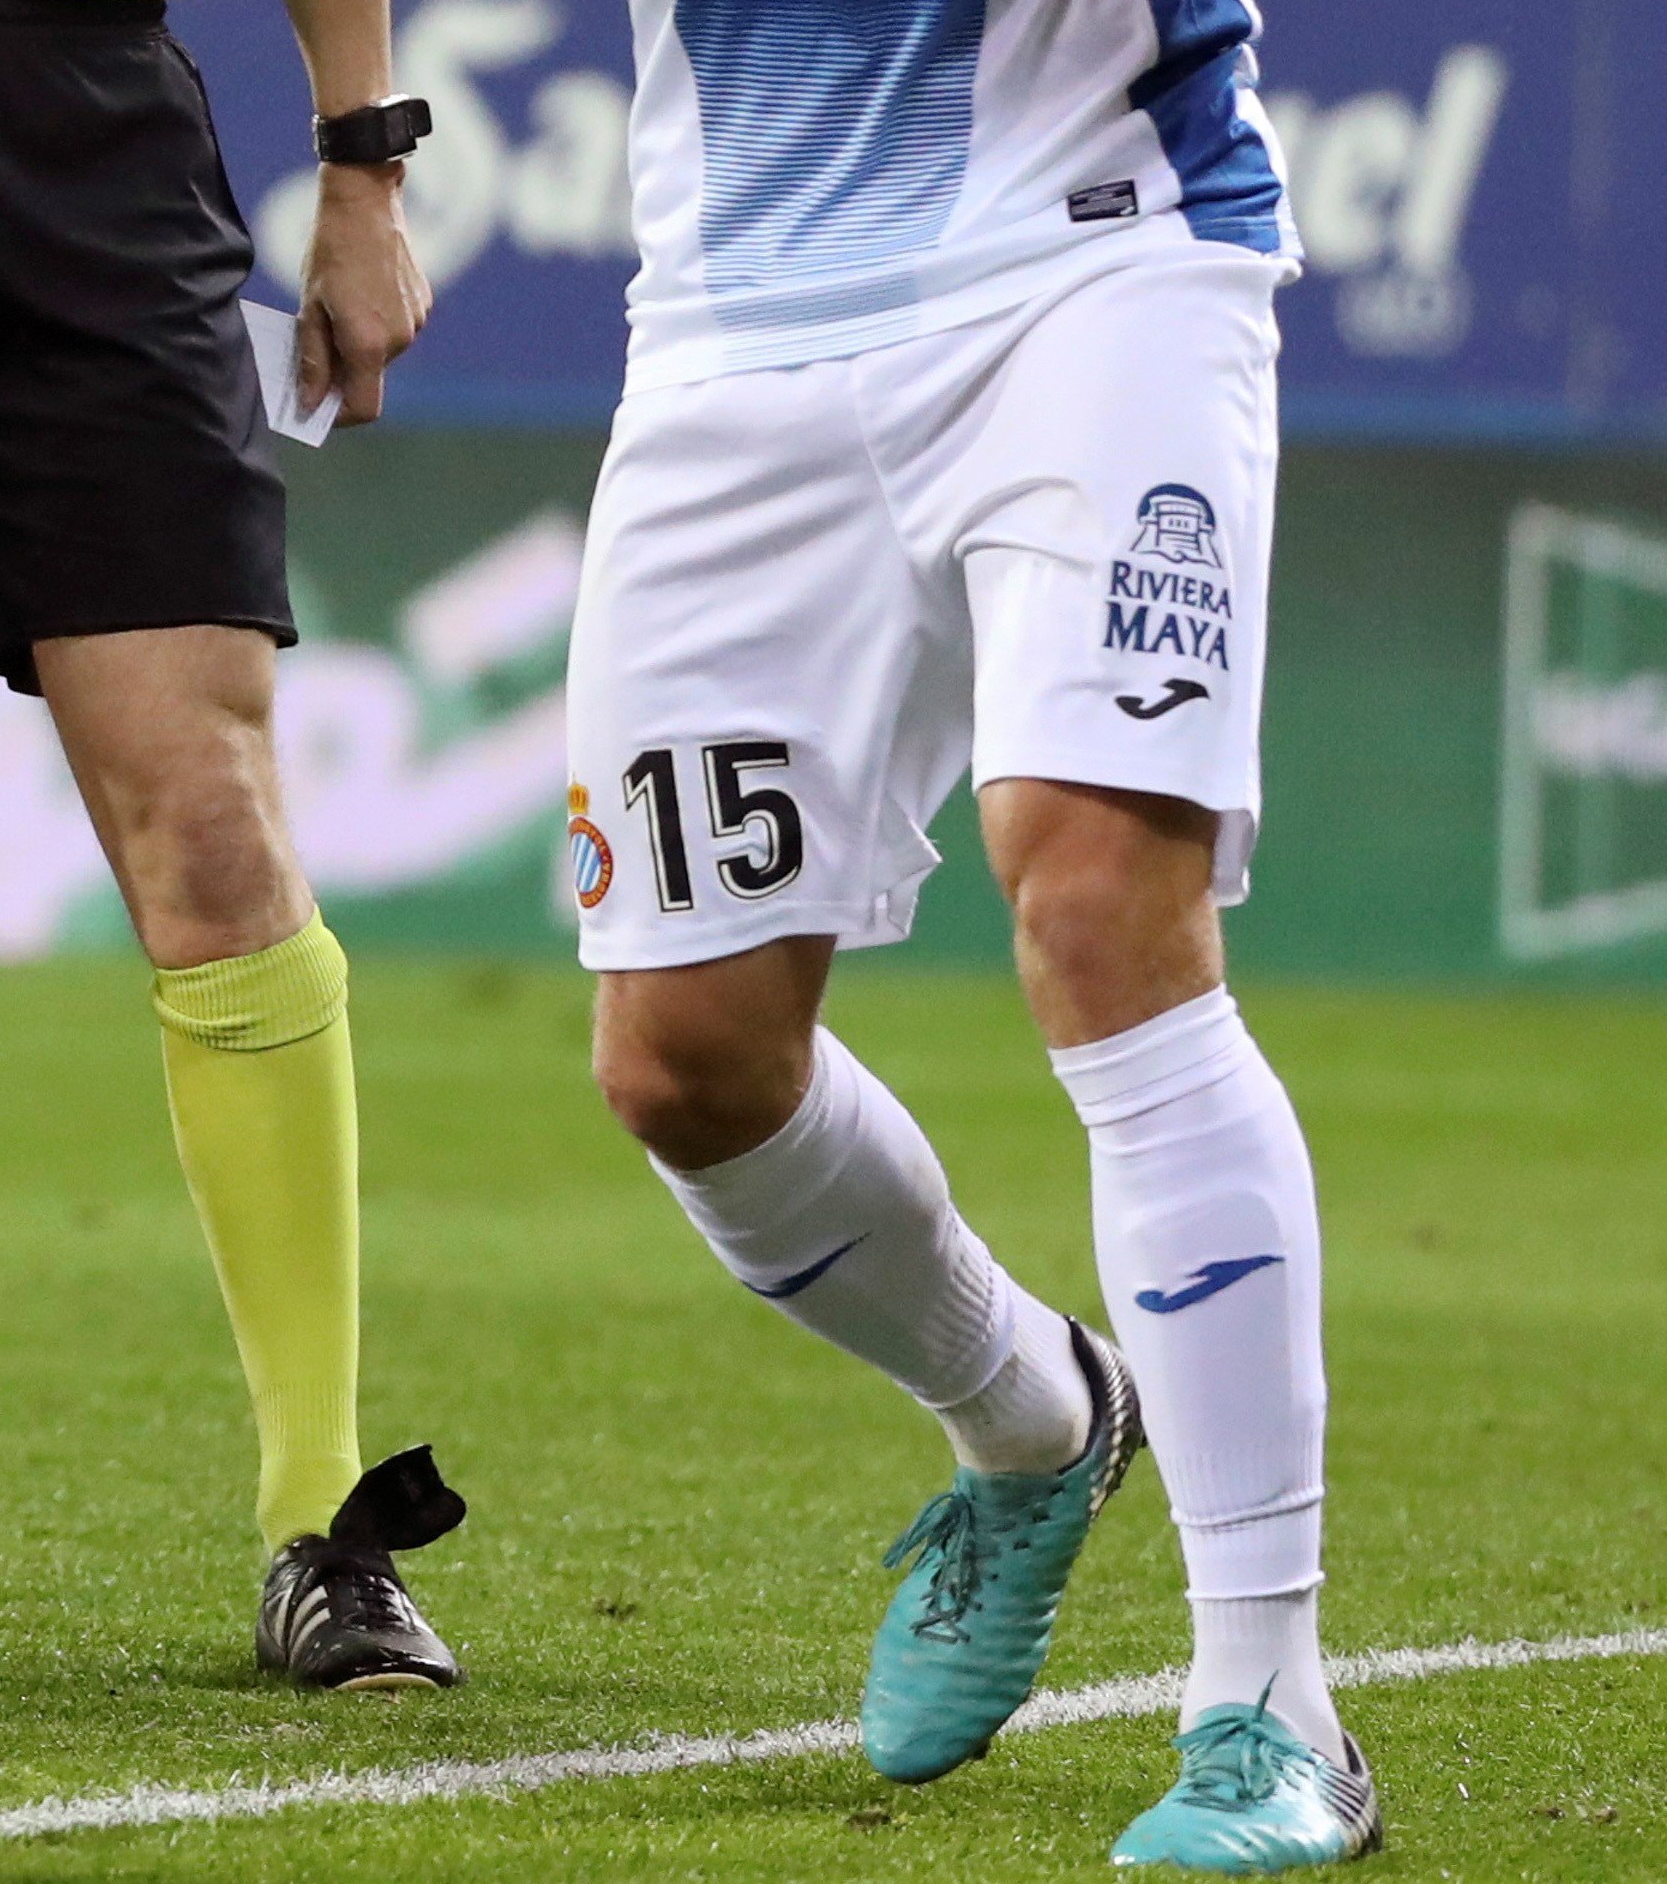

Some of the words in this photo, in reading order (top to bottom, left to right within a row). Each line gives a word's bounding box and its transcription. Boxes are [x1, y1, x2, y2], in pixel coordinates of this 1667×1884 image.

[1110, 560, 1232, 620] RIVIERA
[1103, 601, 1229, 670] MAYA
[622, 742, 803, 913] 15
